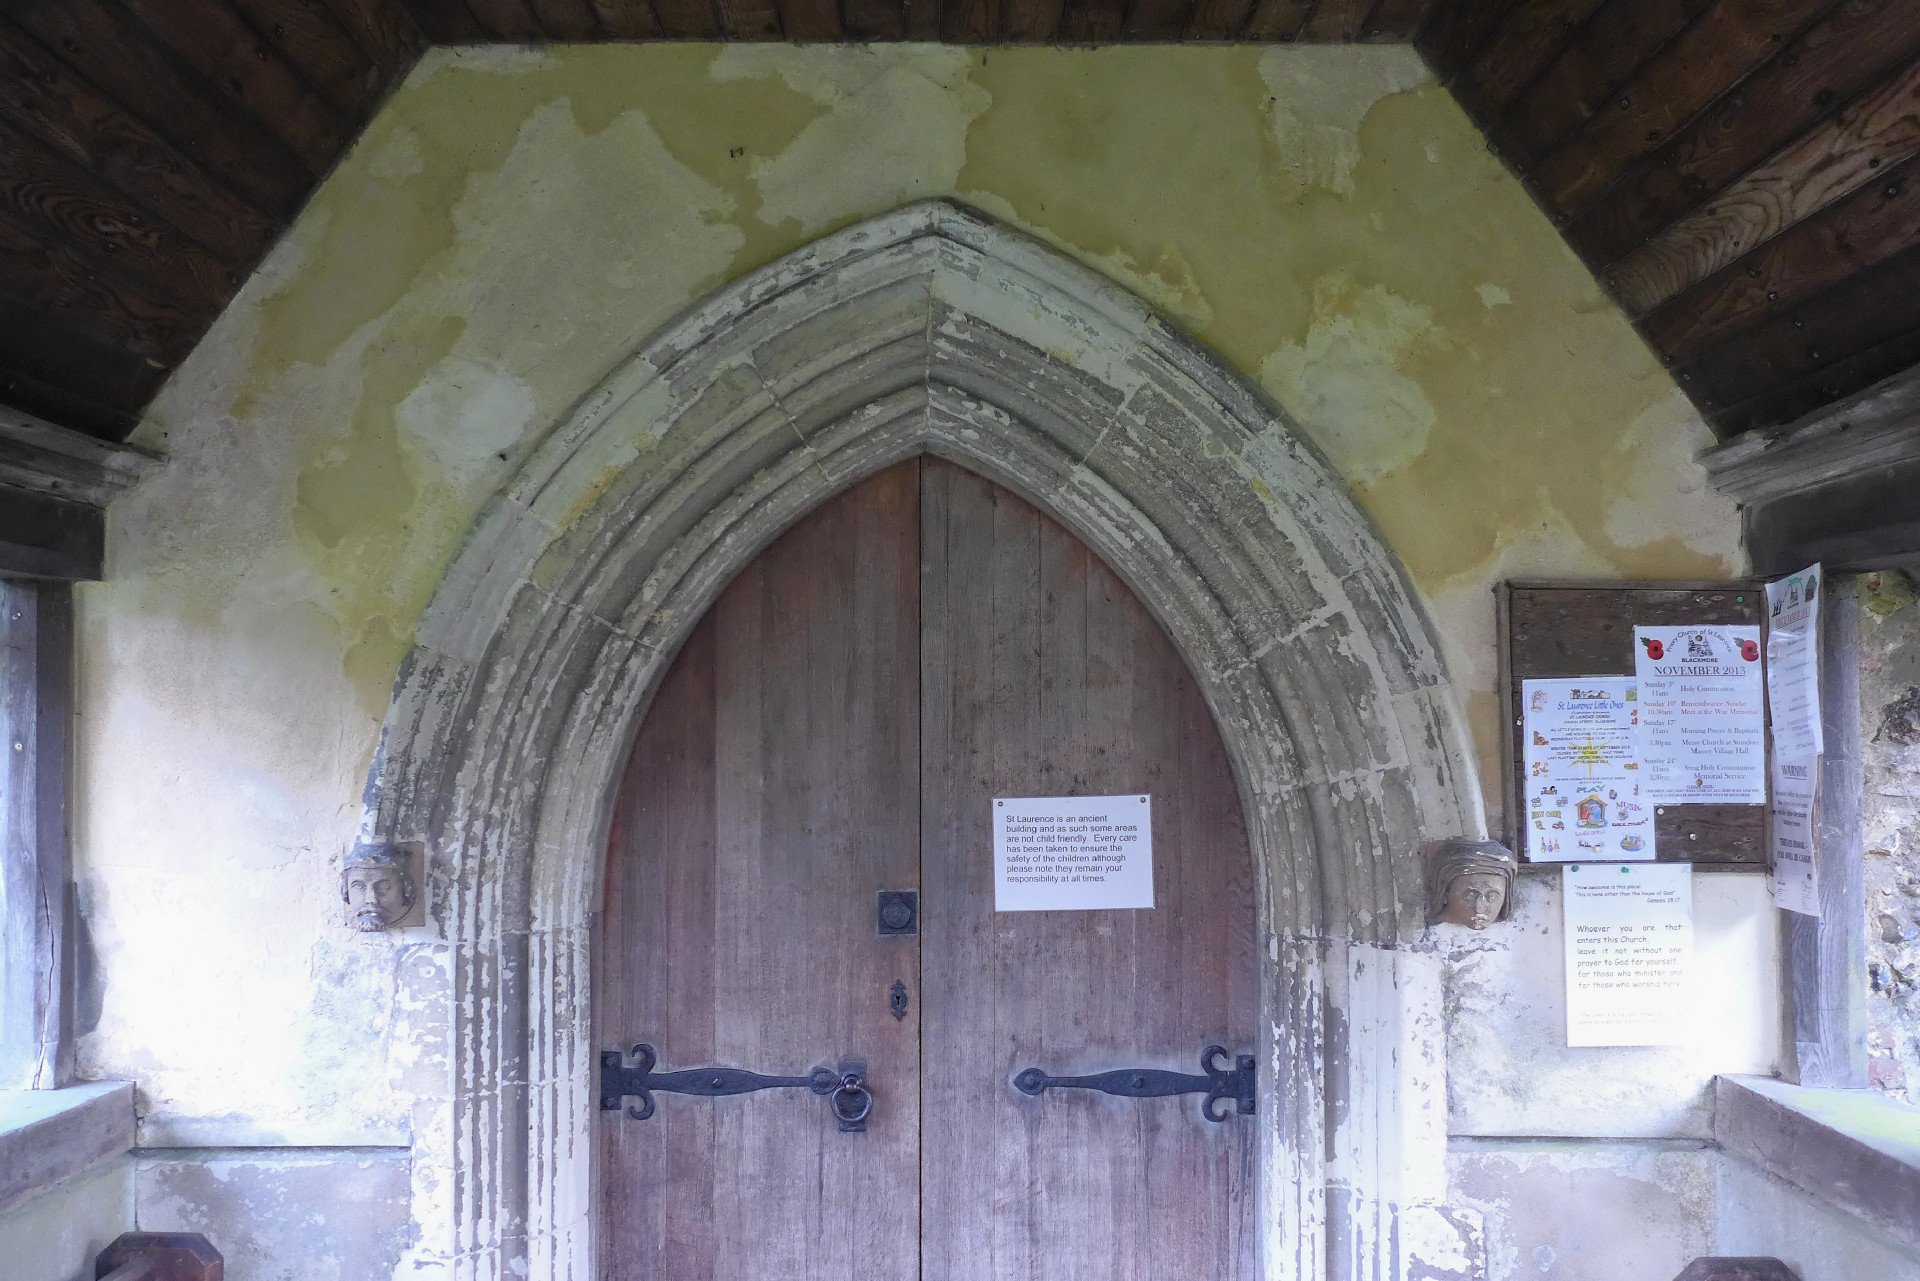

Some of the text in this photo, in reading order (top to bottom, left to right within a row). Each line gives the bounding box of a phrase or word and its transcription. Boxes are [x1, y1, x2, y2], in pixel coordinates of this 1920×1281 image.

[1666, 637, 1679, 653] Priory
[1678, 630, 1698, 638] Church
[1654, 666, 1747, 675] NOVEMBER 2013
[1644, 681, 1666, 690] Sunday
[1680, 686, 1696, 694] Holy
[1558, 699, 1624, 710] St Laurence Little Ones
[1643, 701, 1665, 709] Sunday
[1643, 720, 1665, 728] Sunday
[1682, 739, 1700, 747] Messy
[1714, 747, 1735, 756] Village
[1644, 757, 1665, 765] Sunday
[1684, 765, 1700, 773] Sung
[1701, 765, 1715, 773] Holy
[1781, 765, 1808, 777] WARNING
[1576, 785, 1606, 793] PLAY
[1616, 801, 1643, 811] MUSIC
[1006, 815, 1015, 823] St
[1017, 815, 1054, 823] Laurence
[1006, 825, 1037, 834] building
[1022, 835, 1034, 843] not
[1036, 835, 1055, 843] child
[1093, 834, 1118, 843] Every
[1119, 834, 1138, 842] care
[1110, 844, 1123, 852] the
[1006, 855, 1031, 864] safety
[1032, 855, 1041, 863] of
[1057, 854, 1090, 862] children
[1091, 854, 1127, 864] although
[1006, 864, 1033, 874] please
[1035, 865, 1053, 873] note
[1055, 864, 1073, 875] they
[1105, 864, 1123, 874] your
[1007, 874, 1059, 884] responsibility
[1082, 874, 1107, 882] times.
[1620, 925, 1632, 933] you
[1577, 960, 1601, 968] prayer
[1614, 958, 1629, 966] God
[1632, 980, 1660, 988] worship
